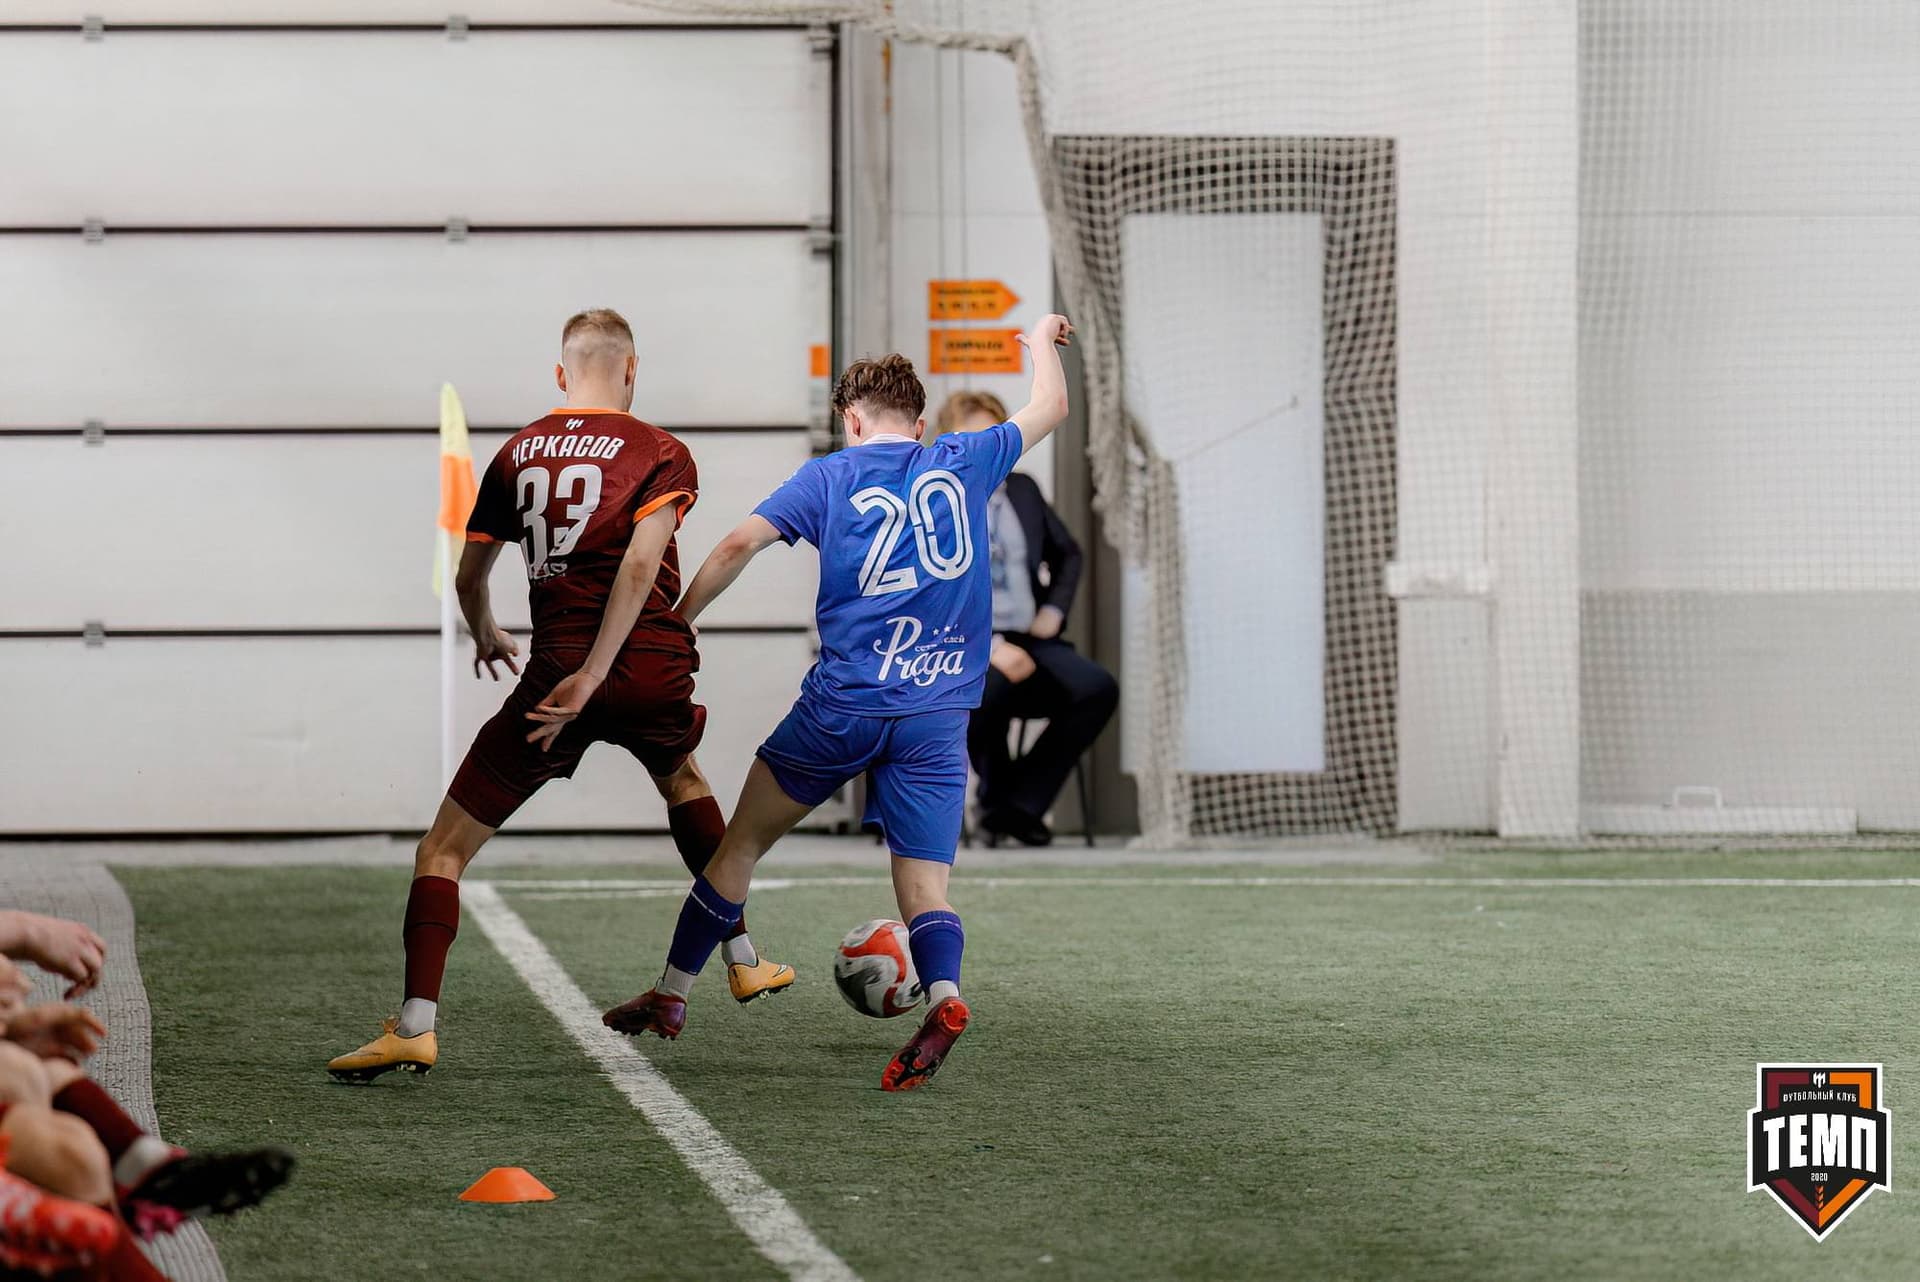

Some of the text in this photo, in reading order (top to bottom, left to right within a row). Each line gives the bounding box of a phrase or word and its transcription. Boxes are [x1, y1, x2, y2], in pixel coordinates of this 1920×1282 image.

[512, 435, 625, 468] ЧЕРКАСОВ
[516, 464, 602, 568] 33
[849, 469, 974, 597] 20
[873, 616, 965, 686] Praga
